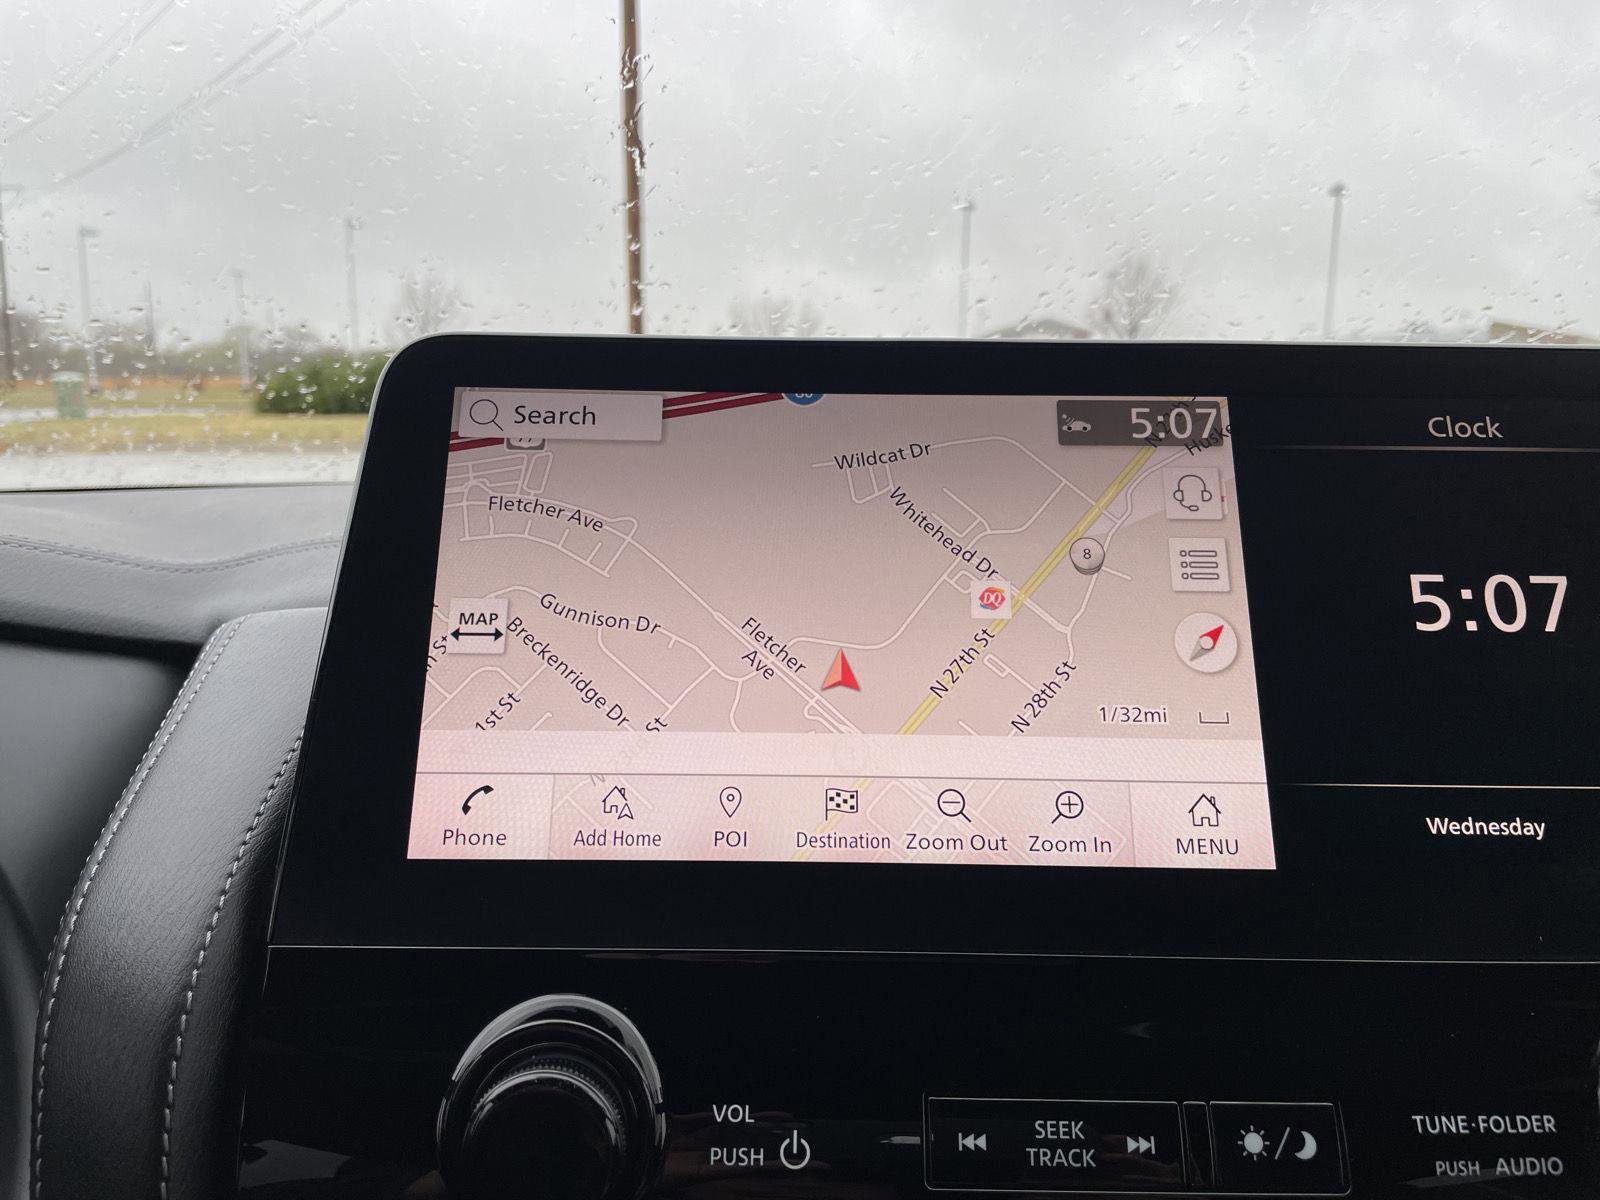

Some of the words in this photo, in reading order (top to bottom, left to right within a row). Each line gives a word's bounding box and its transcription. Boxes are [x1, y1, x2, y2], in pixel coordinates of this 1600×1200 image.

[513, 404, 596, 425] Search
[1130, 407, 1217, 439] 5:07
[1428, 416, 1503, 438] Clock
[834, 447, 905, 472] Wildcat
[908, 443, 932, 460] Dr
[488, 495, 566, 520] Fletcher
[567, 509, 604, 533] Ave
[889, 487, 977, 564] Whitehead
[975, 556, 999, 578] Dr
[1082, 548, 1092, 560] 8
[984, 591, 1002, 608] DQ
[1409, 574, 1568, 633] 5:07
[458, 612, 499, 626] MAP
[540, 593, 630, 630] Gunnison
[636, 616, 662, 635] Dr
[740, 616, 808, 675] Fletcher
[506, 617, 608, 710] Breckenridge
[606, 704, 630, 727] Dr
[740, 648, 776, 681] Ave
[930, 680, 949, 699] N
[940, 646, 985, 687] 27th
[970, 626, 996, 653] St
[1011, 714, 1030, 733] N
[1022, 679, 1064, 720] 28th
[1050, 658, 1078, 686] St
[475, 708, 505, 731] 1st
[497, 692, 522, 715] St
[1099, 705, 1168, 724] 1/32mi
[645, 717, 669, 732] St
[442, 829, 507, 847] Phone
[573, 830, 607, 847] Add
[613, 830, 662, 847] Home
[713, 830, 748, 848] POI
[1425, 816, 1546, 841] Wednesday
[795, 831, 891, 849] Destination
[905, 833, 964, 851] Zoom
[969, 833, 1008, 851] Out
[1028, 835, 1087, 853] Zoom
[1093, 837, 1112, 853] In
[1176, 837, 1239, 855] MENU
[712, 1104, 755, 1124] VOL
[1034, 1120, 1085, 1140] SEEK
[709, 1147, 764, 1167] PUSH
[1025, 1147, 1097, 1169] TRACK
[1435, 1159, 1480, 1176] PUSH
[1495, 1156, 1564, 1177] AUDIO
